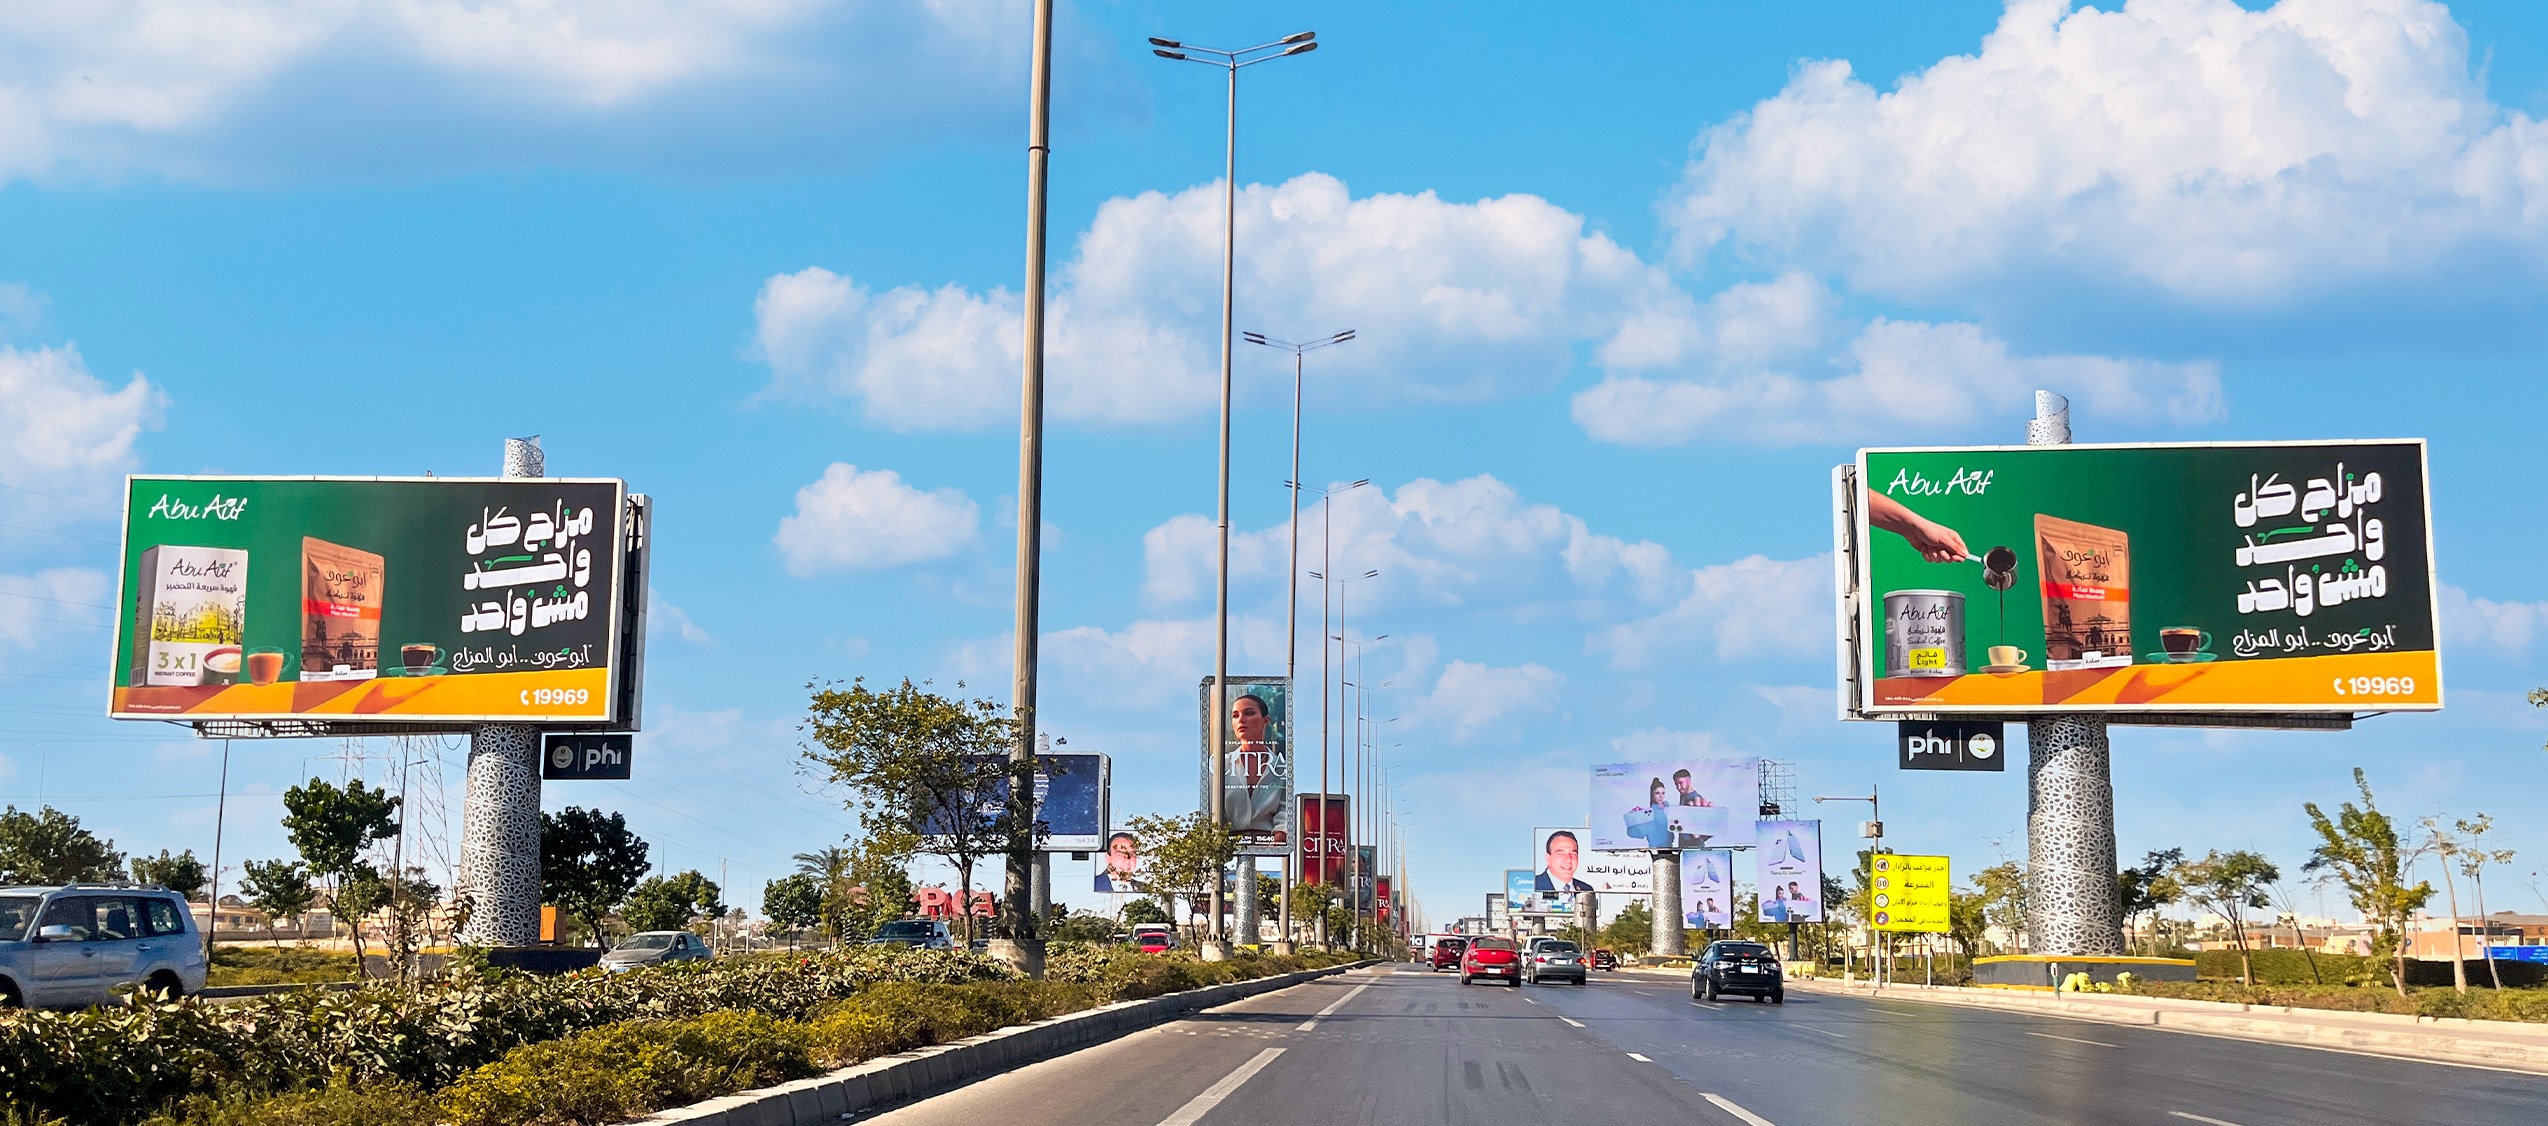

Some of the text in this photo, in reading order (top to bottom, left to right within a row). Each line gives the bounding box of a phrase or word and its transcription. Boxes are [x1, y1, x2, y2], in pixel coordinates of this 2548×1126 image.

[1887, 466, 1994, 496] Abu Auf
[2234, 462, 2381, 528] مزاج كل
[148, 493, 248, 520] Abu Auf
[466, 498, 593, 555] مزاج كل
[171, 558, 234, 578] Abu Auf
[2237, 564, 2314, 617] واحد
[461, 588, 527, 636] واحد
[1900, 603, 1951, 621] Abu Auf
[2232, 627, 2281, 658] المزاج
[157, 651, 169, 669] 3
[190, 653, 197, 669] 1
[453, 646, 494, 672] المزاج
[1916, 659, 1938, 667] Light
[532, 688, 589, 705] 19969
[2347, 676, 2415, 695] 19969
[584, 742, 622, 772] phi
[1908, 728, 1952, 762] phi
